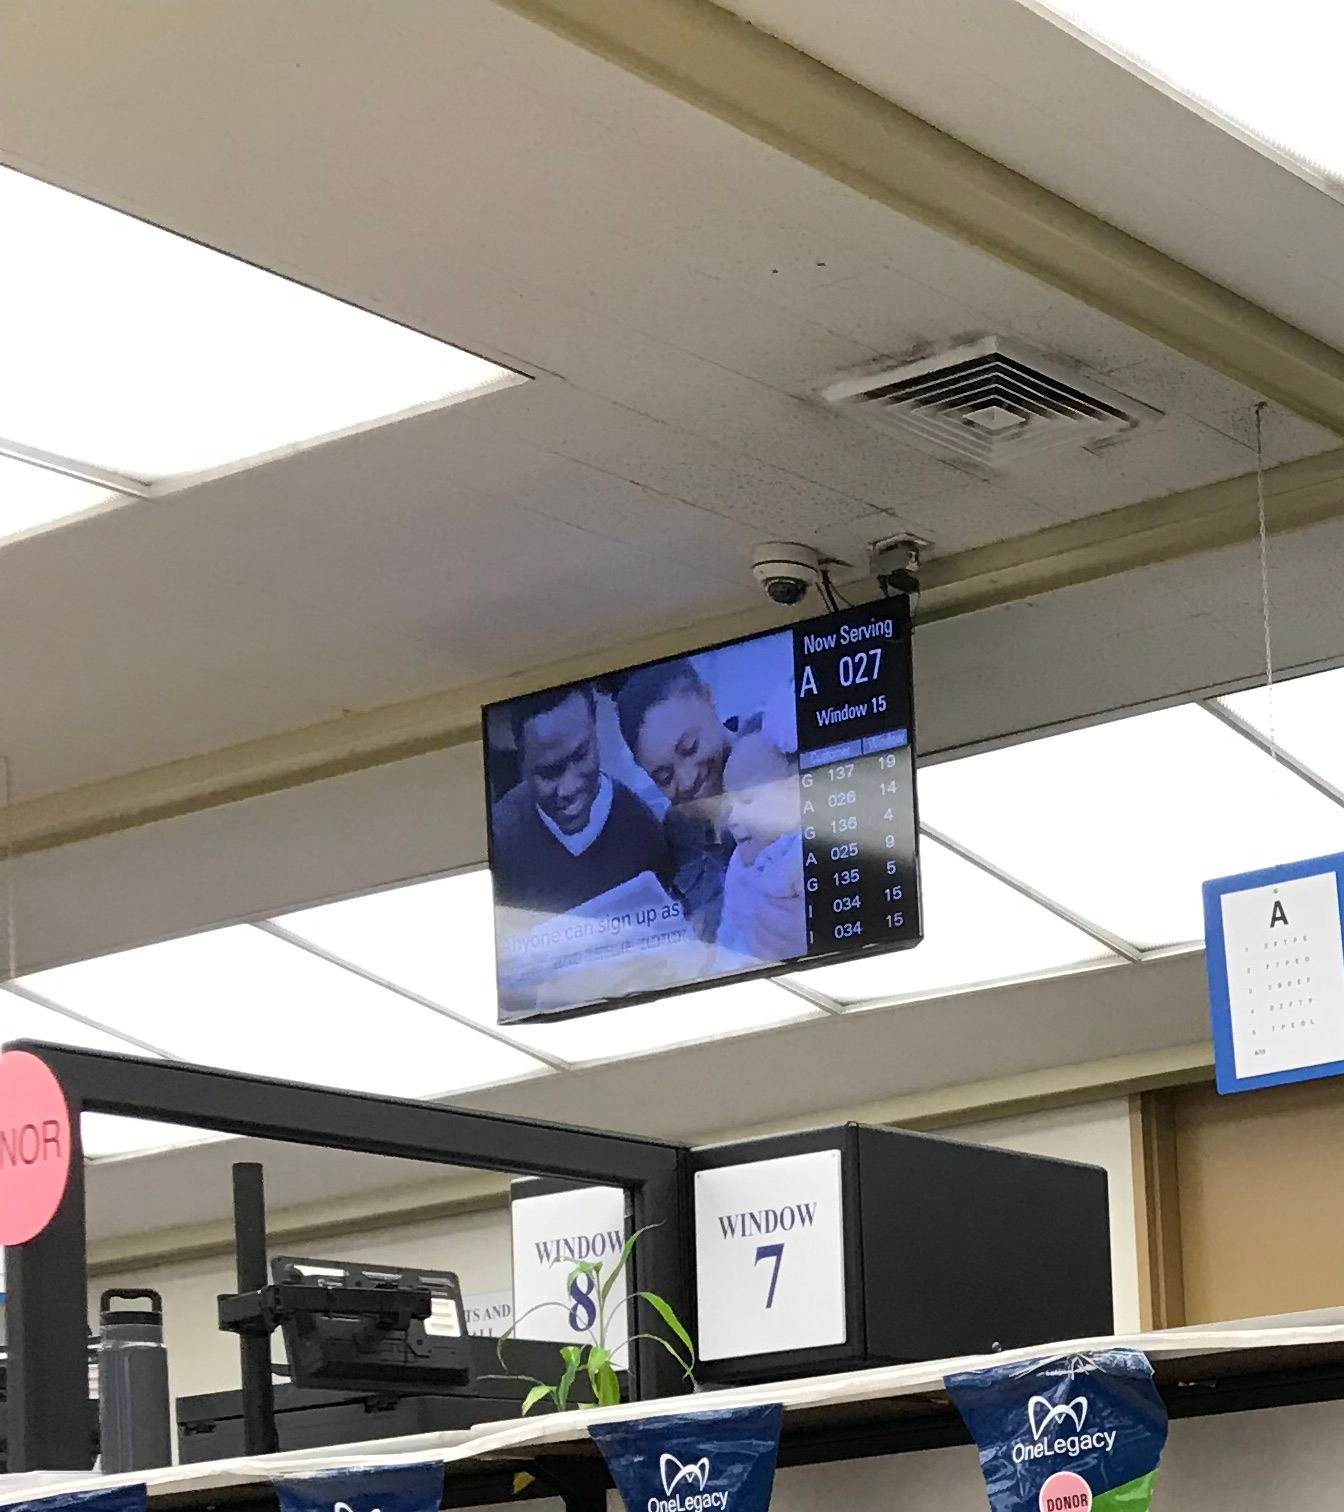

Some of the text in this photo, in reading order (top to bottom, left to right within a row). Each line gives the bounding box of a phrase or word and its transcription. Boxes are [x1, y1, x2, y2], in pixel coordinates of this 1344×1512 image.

[804, 618, 893, 655] Now Serving
[800, 649, 882, 697] A 027
[816, 695, 887, 727] Window 15
[802, 754, 896, 787] G 137 19
[803, 780, 897, 814] A 026 14
[804, 808, 893, 840] G 136 4
[806, 835, 895, 867] A 025 9
[806, 861, 896, 892] G 135 5
[833, 895, 861, 913] 034
[884, 886, 902, 902] 15
[1270, 900, 1289, 928] A
[565, 922, 594, 939] can
[598, 912, 631, 935] sign
[636, 908, 657, 924] up
[661, 902, 680, 918] as
[834, 921, 863, 939] 034
[886, 912, 904, 928] 15
[0, 1120, 62, 1170] NOR
[718, 1202, 817, 1240] WINDOW
[534, 1230, 626, 1264] WINDOW
[754, 1243, 785, 1309] 7
[483, 1303, 511, 1321] AND
[568, 1270, 596, 1332] 8
[1012, 1430, 1117, 1464] OneLegacy
[1047, 1493, 1089, 1512] DONOR
